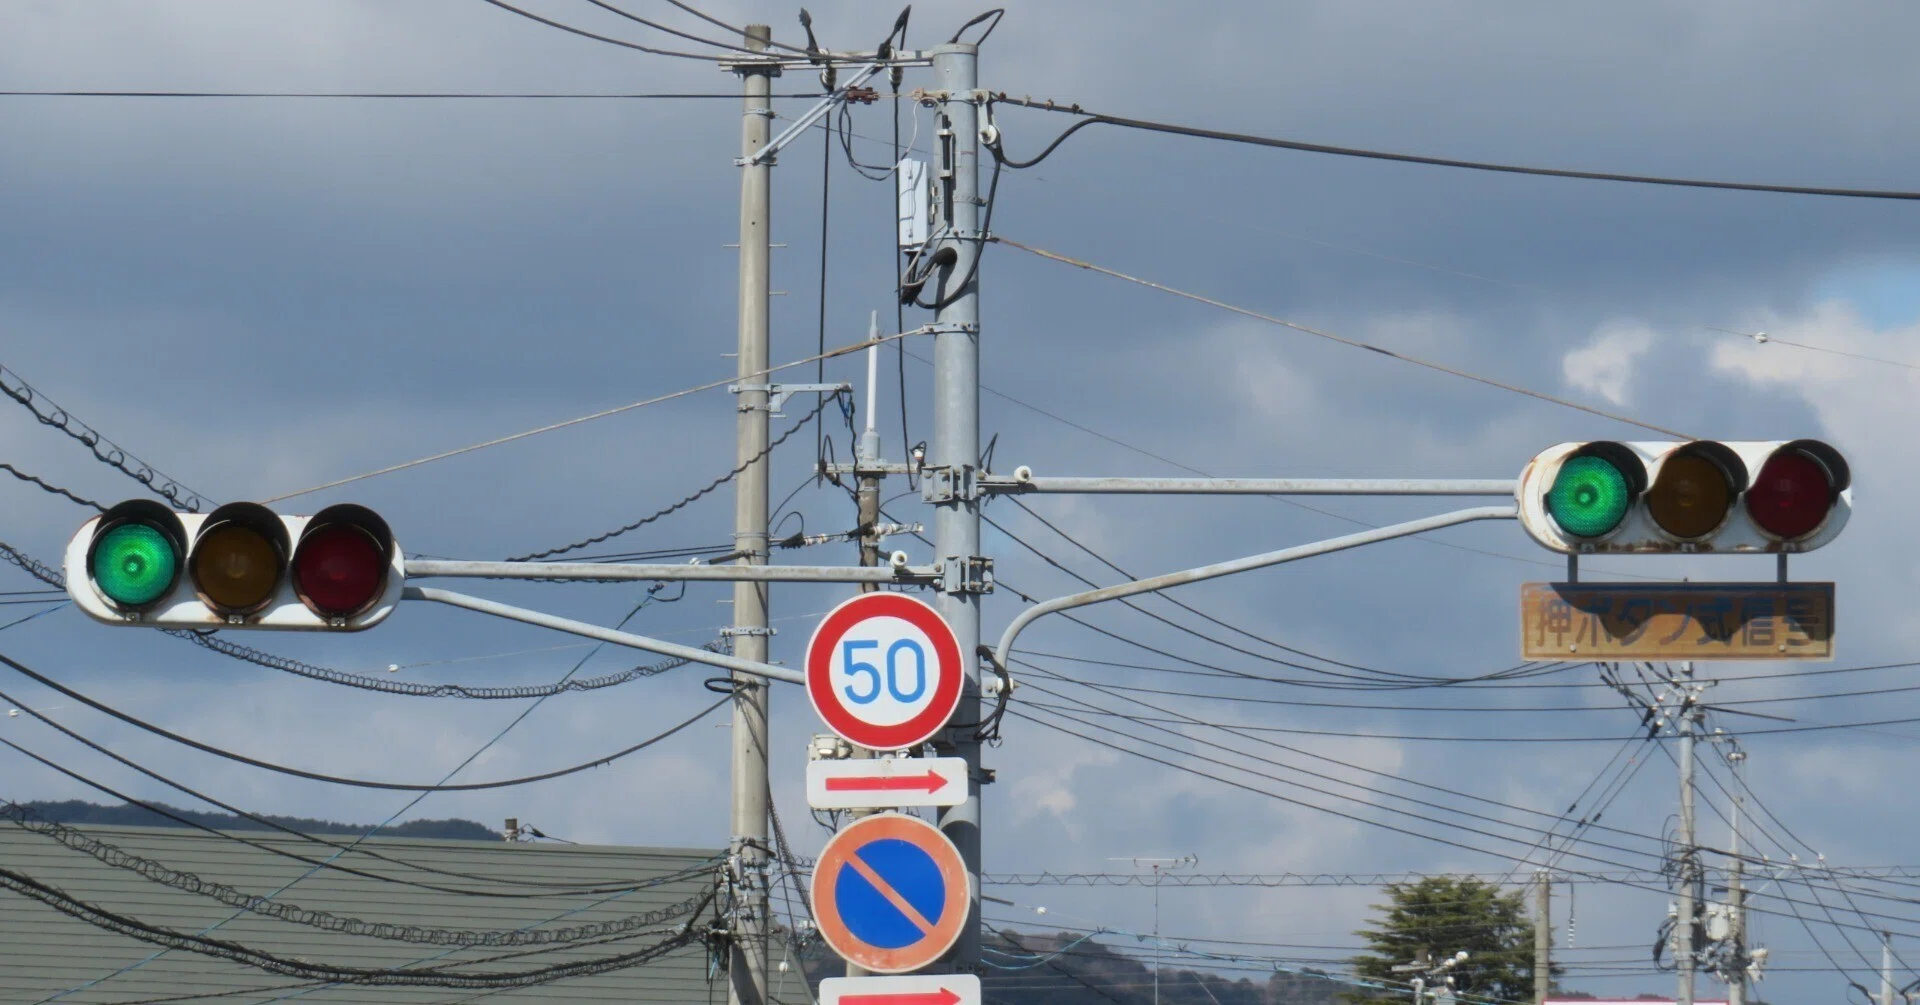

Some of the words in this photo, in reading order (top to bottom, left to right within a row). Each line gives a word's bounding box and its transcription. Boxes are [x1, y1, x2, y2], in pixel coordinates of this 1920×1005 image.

[1536, 595, 1821, 647] 押ボタン式信号
[842, 638, 926, 705] 50
